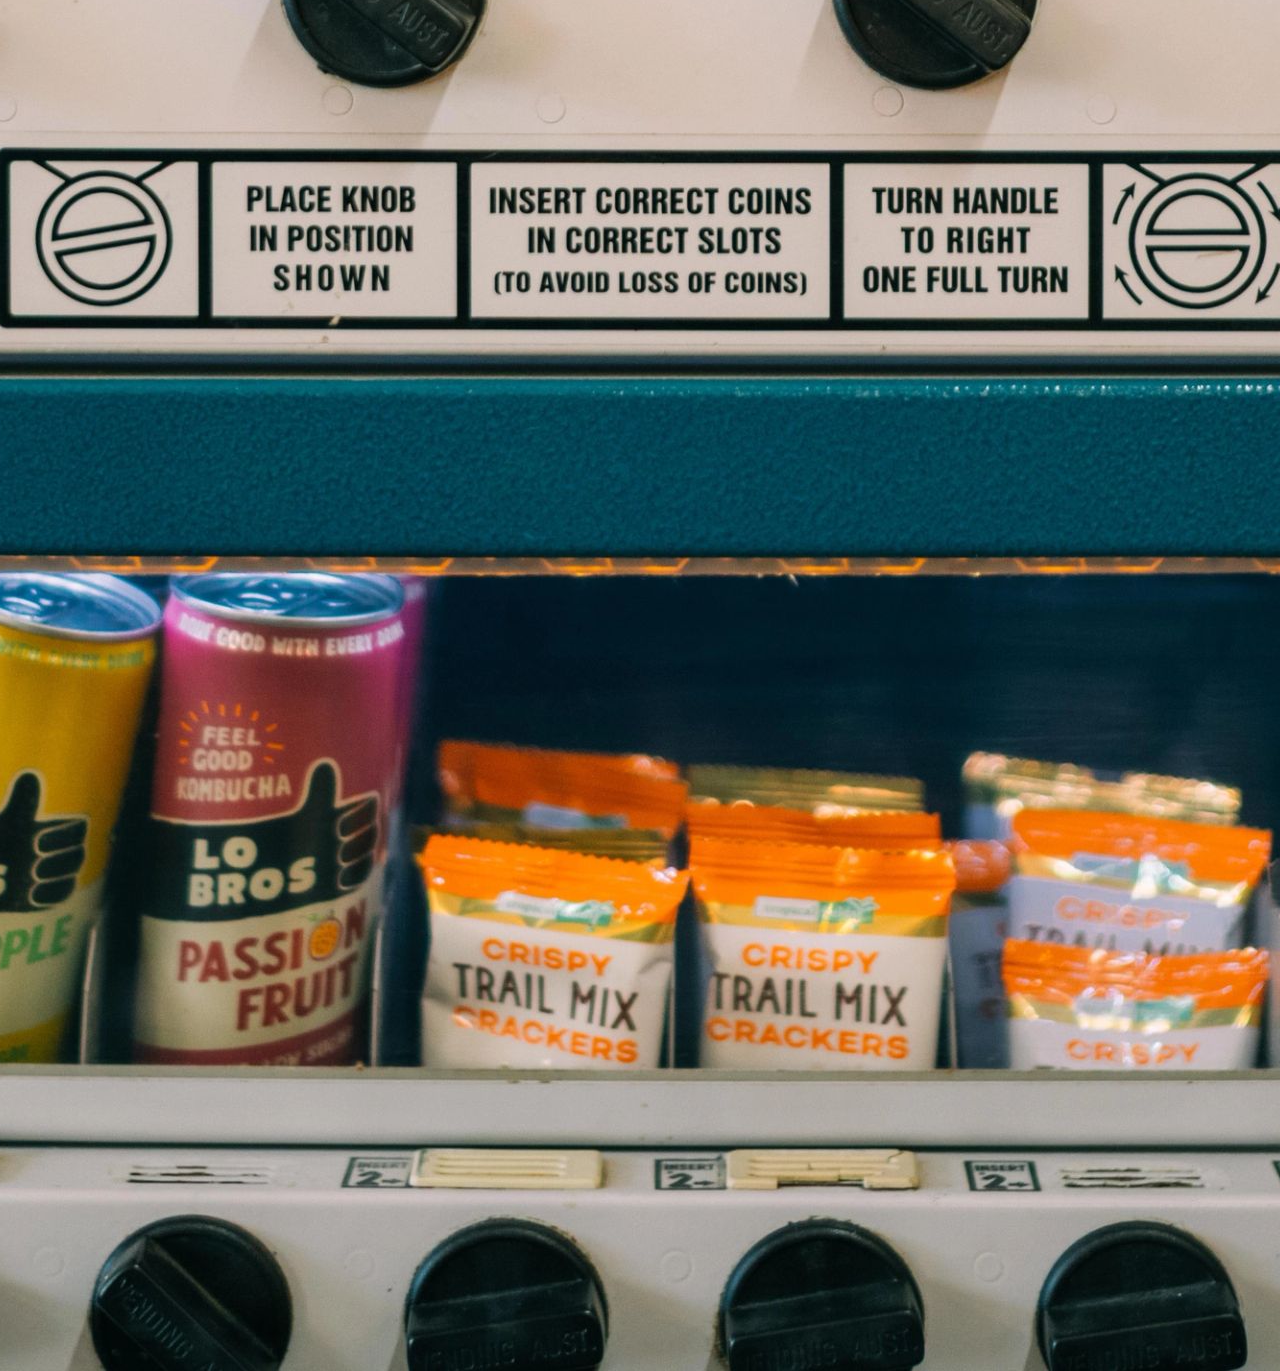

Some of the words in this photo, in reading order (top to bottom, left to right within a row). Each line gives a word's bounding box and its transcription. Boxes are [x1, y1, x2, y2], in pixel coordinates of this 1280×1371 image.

[246, 185, 332, 213] PLACE
[342, 185, 416, 213] KNOB
[489, 187, 587, 215] INSERT
[595, 187, 719, 215] CORRECT
[728, 187, 812, 215] COINS
[871, 187, 943, 215] TURN
[953, 187, 1059, 215] HANDLE
[249, 225, 278, 252] IN
[287, 225, 414, 253] POSITION
[528, 226, 556, 254] IN
[565, 226, 689, 255] CORRECT
[698, 226, 782, 255] SLOTS
[900, 226, 934, 254] TO
[946, 226, 1031, 254] RIGHT
[273, 264, 390, 292] SHOWN
[494, 271, 531, 295] (TO
[539, 271, 610, 294] AVOID
[618, 271, 679, 294] LOSS
[688, 271, 716, 294] OF
[724, 271, 807, 296] COINS)
[862, 265, 917, 293] ONE
[926, 266, 989, 294] FULL
[997, 266, 1068, 294] TURN
[272, 636, 319, 657] WITH
[202, 725, 261, 748] FEEL
[193, 748, 253, 772] GOOD
[177, 774, 292, 802] KOMBUCHA
[194, 836, 258, 870] LO
[188, 857, 317, 908] BROS
[482, 937, 613, 977] CRISPY
[742, 943, 879, 975] CRISPY
[236, 954, 359, 1031] FRUIT
[452, 963, 554, 1014] TRAIL
[570, 980, 638, 1031] MIX
[713, 972, 816, 1019] TRAIL
[835, 982, 908, 1027] MIX
[452, 1005, 638, 1064] CRACKERS
[706, 1017, 910, 1060] CRACKERS
[1065, 1038, 1201, 1066] CRISPY
